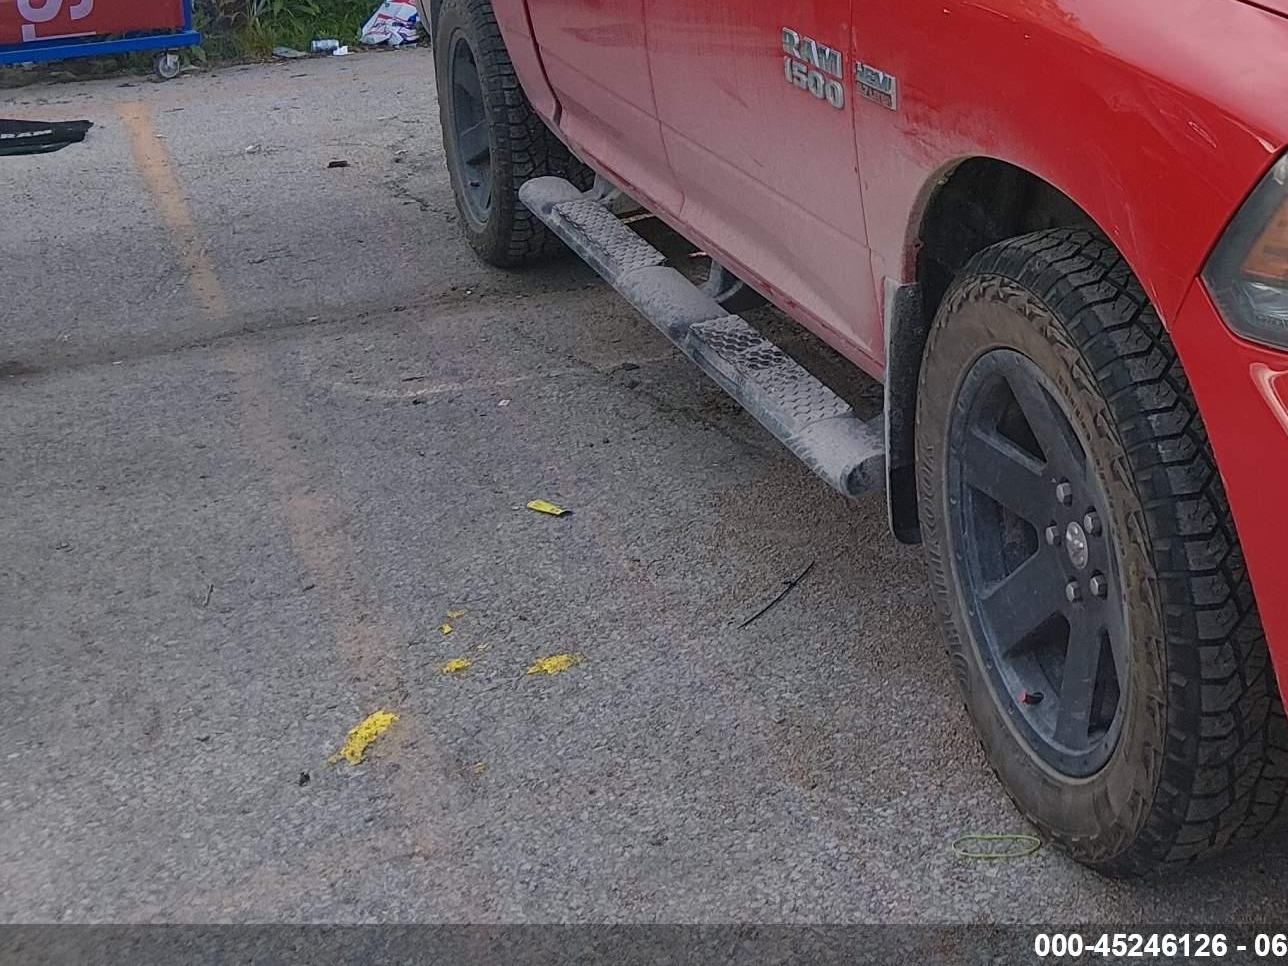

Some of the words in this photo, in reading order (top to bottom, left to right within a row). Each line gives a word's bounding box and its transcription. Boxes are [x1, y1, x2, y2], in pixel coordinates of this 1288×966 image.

[782, 26, 844, 79] RAM
[855, 60, 897, 95] HEMI
[783, 56, 845, 110] 1500
